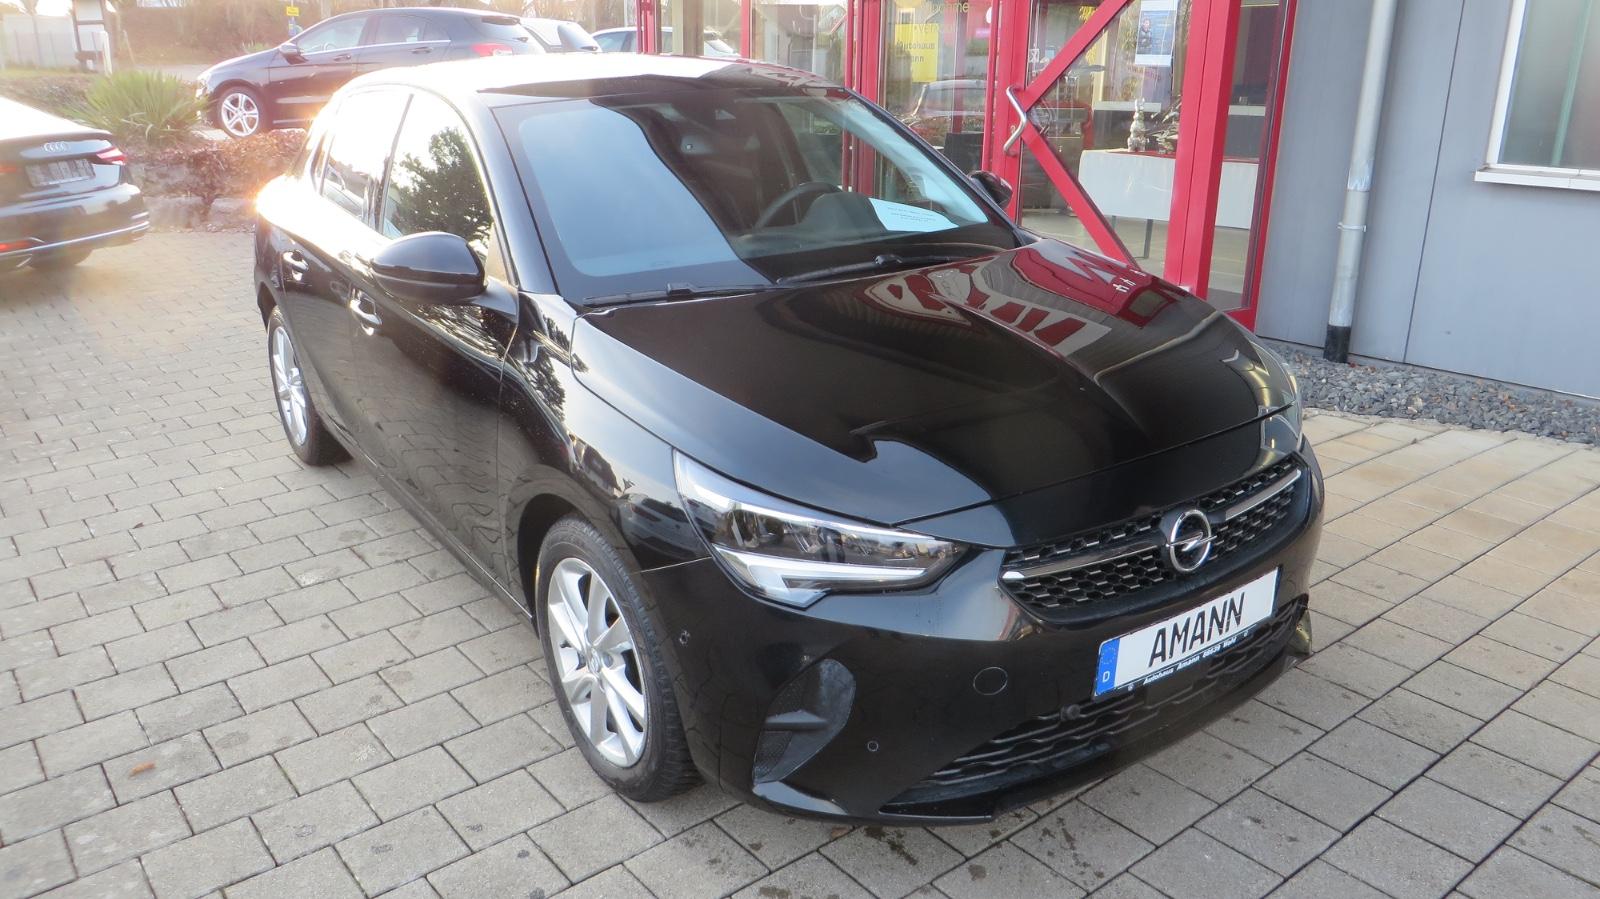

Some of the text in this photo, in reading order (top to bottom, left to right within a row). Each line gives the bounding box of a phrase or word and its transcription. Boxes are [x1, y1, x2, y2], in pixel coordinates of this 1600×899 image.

[1148, 592, 1245, 667] AMANN
[1102, 670, 1110, 683] D
[1142, 667, 1174, 686] Autohaus
[1176, 654, 1200, 671] Amann
